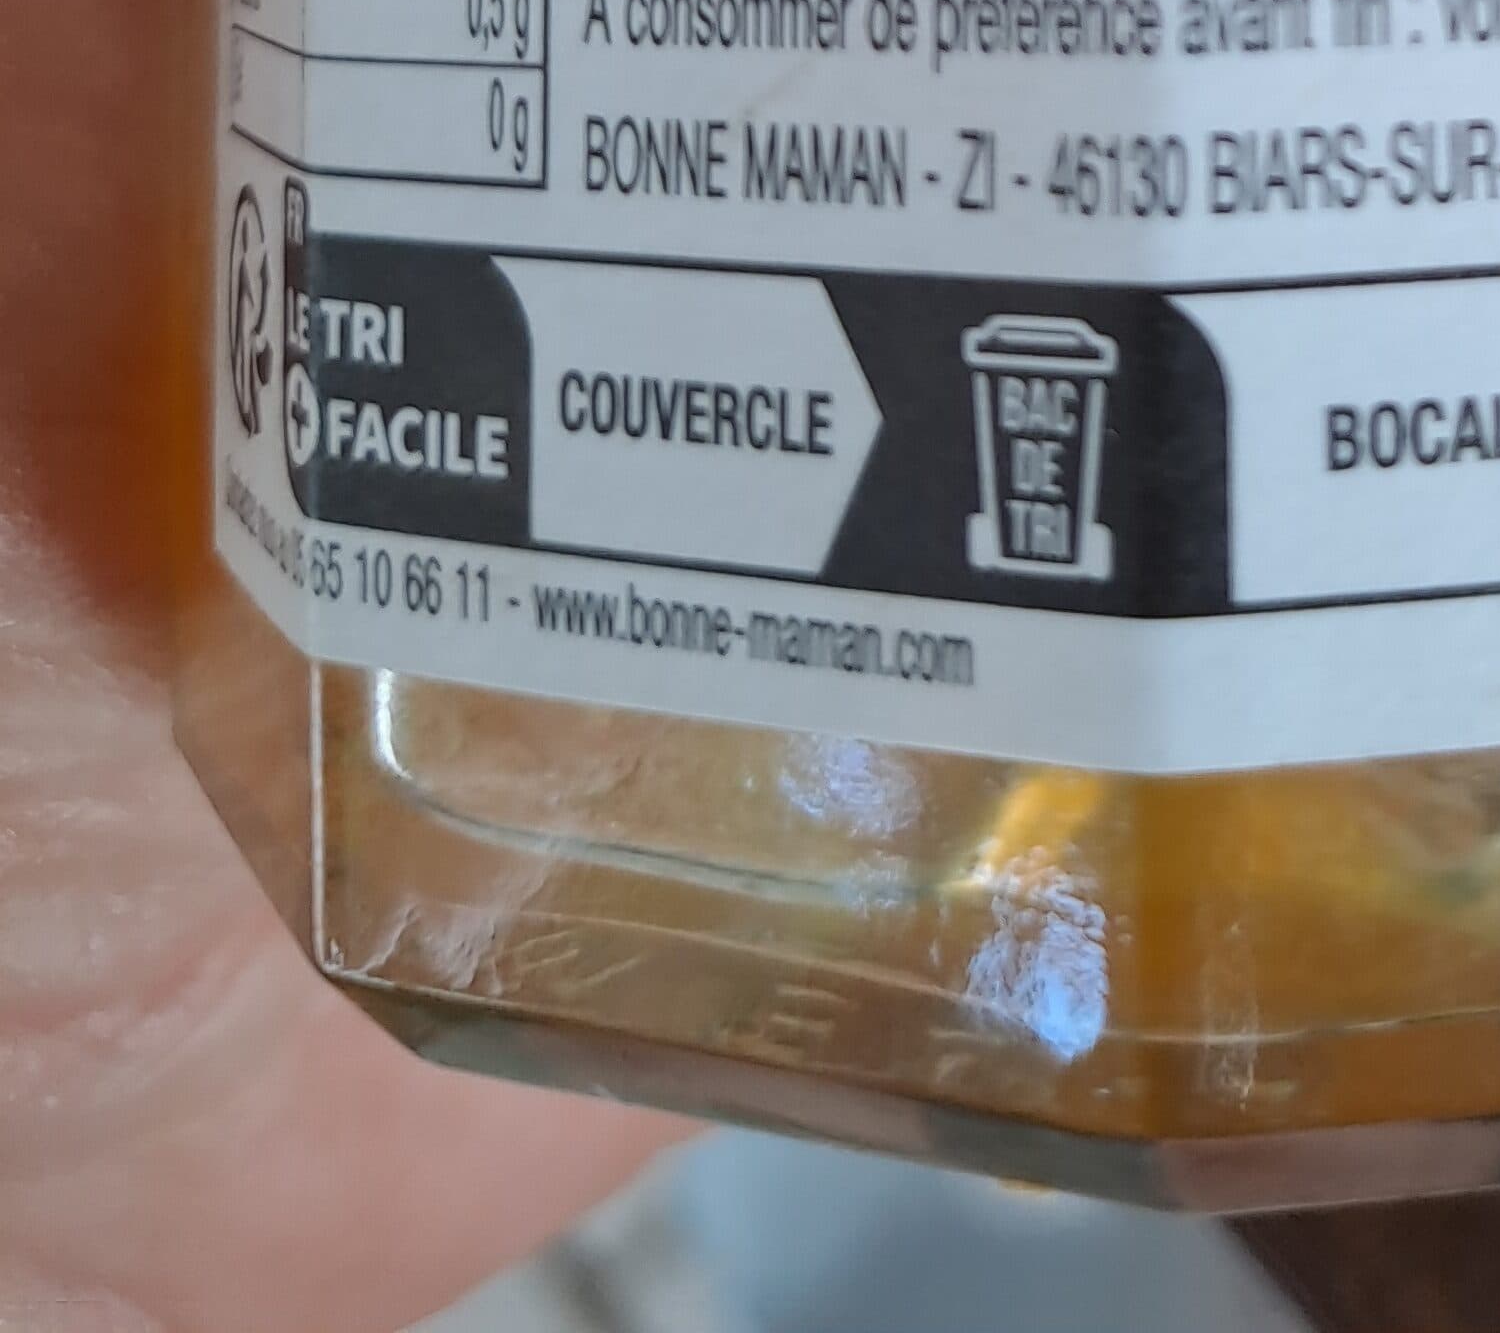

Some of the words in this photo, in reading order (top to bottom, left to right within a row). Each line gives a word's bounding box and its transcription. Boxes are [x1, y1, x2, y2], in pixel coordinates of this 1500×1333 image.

[489, 77, 505, 151] 0
[513, 97, 529, 171] g
[585, 115, 729, 199] BONNE
[743, 120, 906, 207] MAMAN
[956, 129, 995, 211] ZI
[1049, 133, 1188, 218] 46130
[286, 286, 310, 351] LE
[319, 296, 405, 365] TRI
[326, 397, 509, 480] FACILE
[560, 368, 833, 455] COUVERCLE
[999, 376, 1077, 434] BAC
[1010, 437, 1066, 496] DE
[1006, 497, 1071, 559] TRI
[311, 541, 342, 600] 65
[356, 546, 392, 608] 10
[404, 552, 443, 616] 66
[456, 563, 491, 624] 11
[533, 582, 976, 687] www.bonne-maman.com
